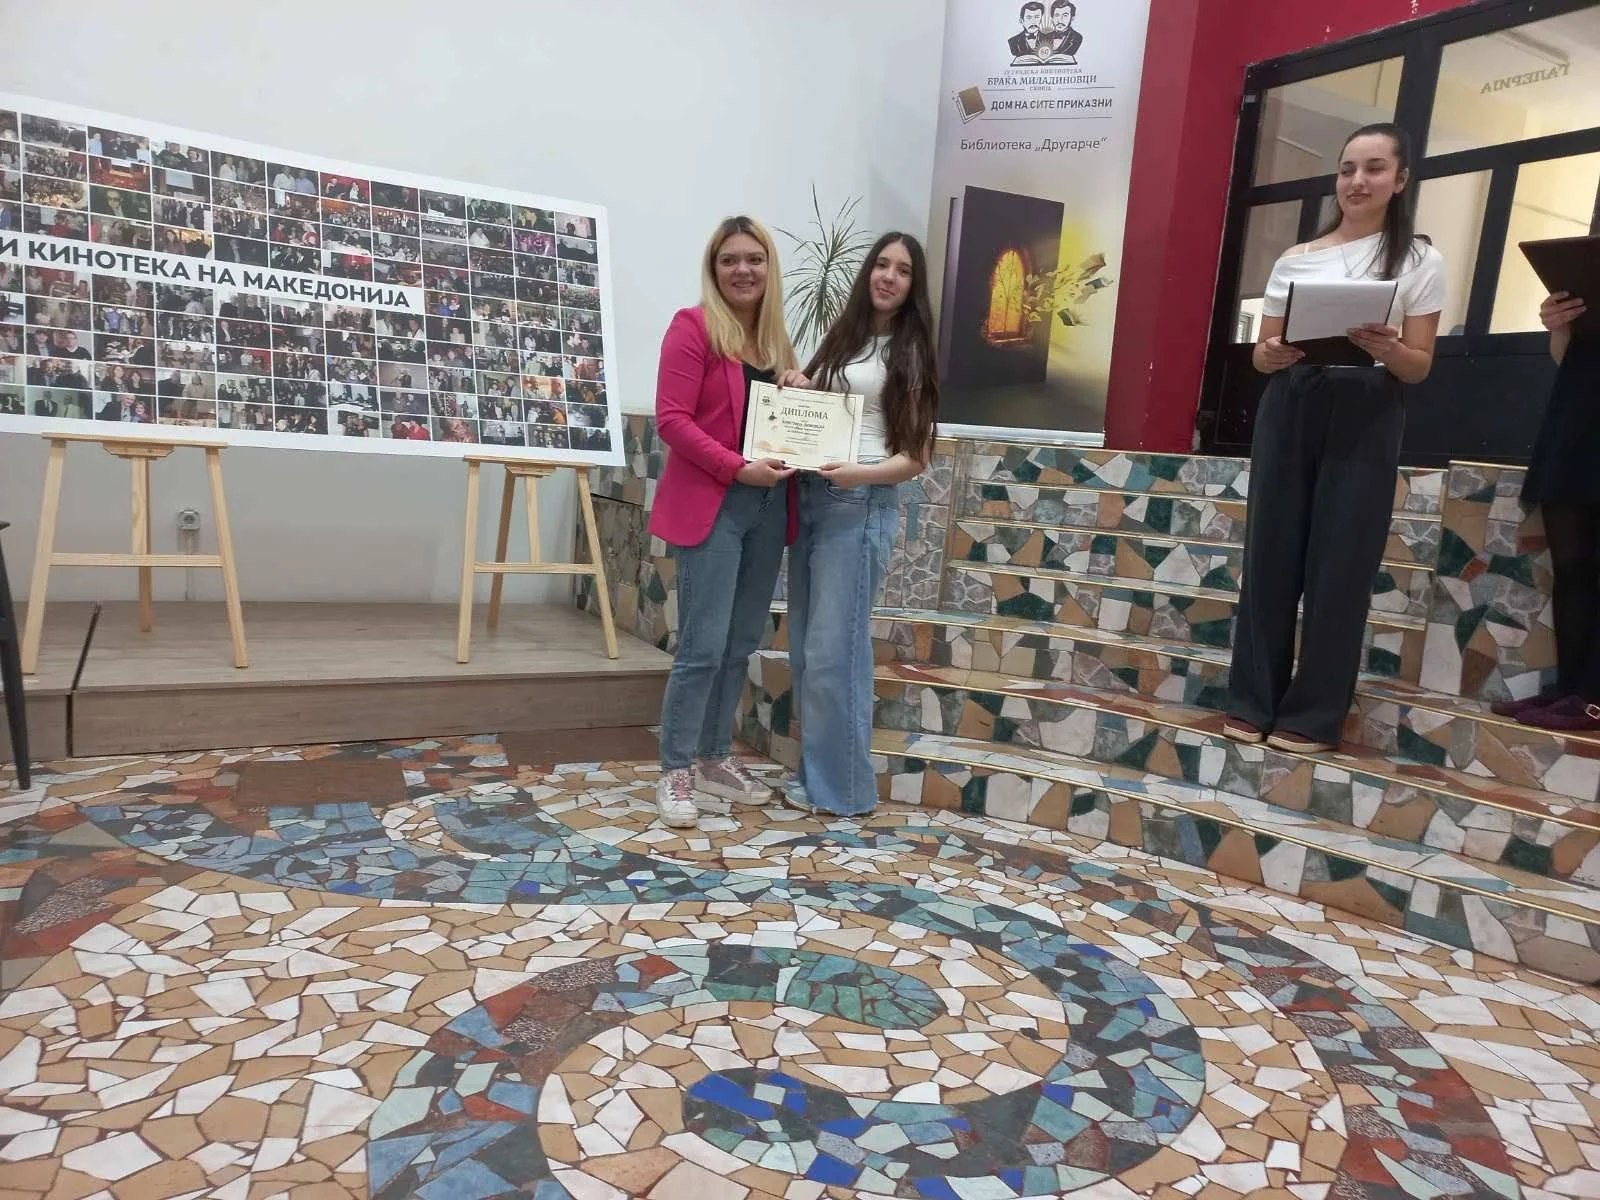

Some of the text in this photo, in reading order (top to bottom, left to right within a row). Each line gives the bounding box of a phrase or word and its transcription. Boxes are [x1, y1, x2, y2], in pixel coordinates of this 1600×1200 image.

[1019, 75, 1097, 86] МИЛАДИНОВЦИ
[991, 99, 1112, 111] ДОМ НА СИТЕ ПРИКАЗНИ
[960, 138, 1032, 150] Библиотека
[28, 240, 190, 280] КИНОТЕКА
[199, 264, 236, 286] НА
[243, 269, 411, 308] МАКЕДОНИЈА
[781, 407, 828, 420] ДИПЛОМА
